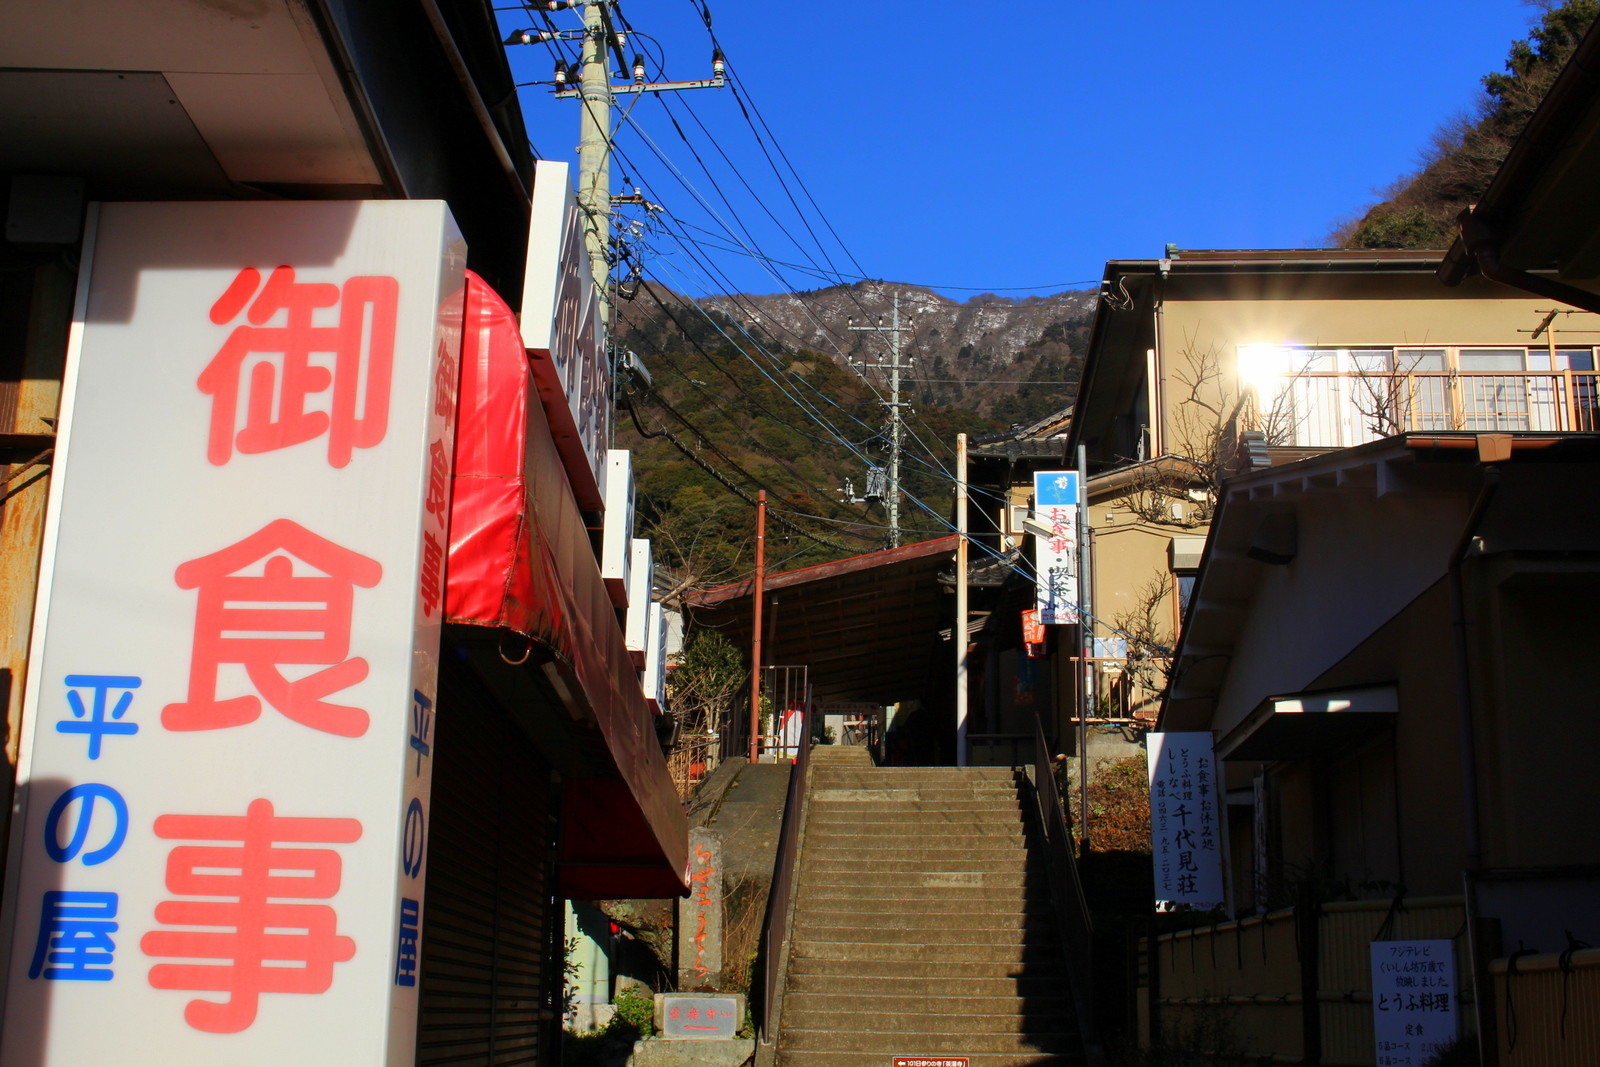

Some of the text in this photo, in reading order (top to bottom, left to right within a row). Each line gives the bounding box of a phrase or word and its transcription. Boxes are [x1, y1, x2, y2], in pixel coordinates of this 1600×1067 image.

[141, 265, 400, 1035] 御食事
[1168, 748, 1181, 800] ししなべ
[1181, 748, 1194, 801] とうふ料理
[28, 673, 142, 983] 平の屋
[395, 688, 431, 988] 平の屋
[1171, 804, 1199, 895] 千代見荘
[1380, 962, 1446, 974] くいしん坊万歳で
[1390, 946, 1431, 957] フジテレビ
[1378, 992, 1450, 1012] とうふ料理
[1405, 1024, 1424, 1036] 定食
